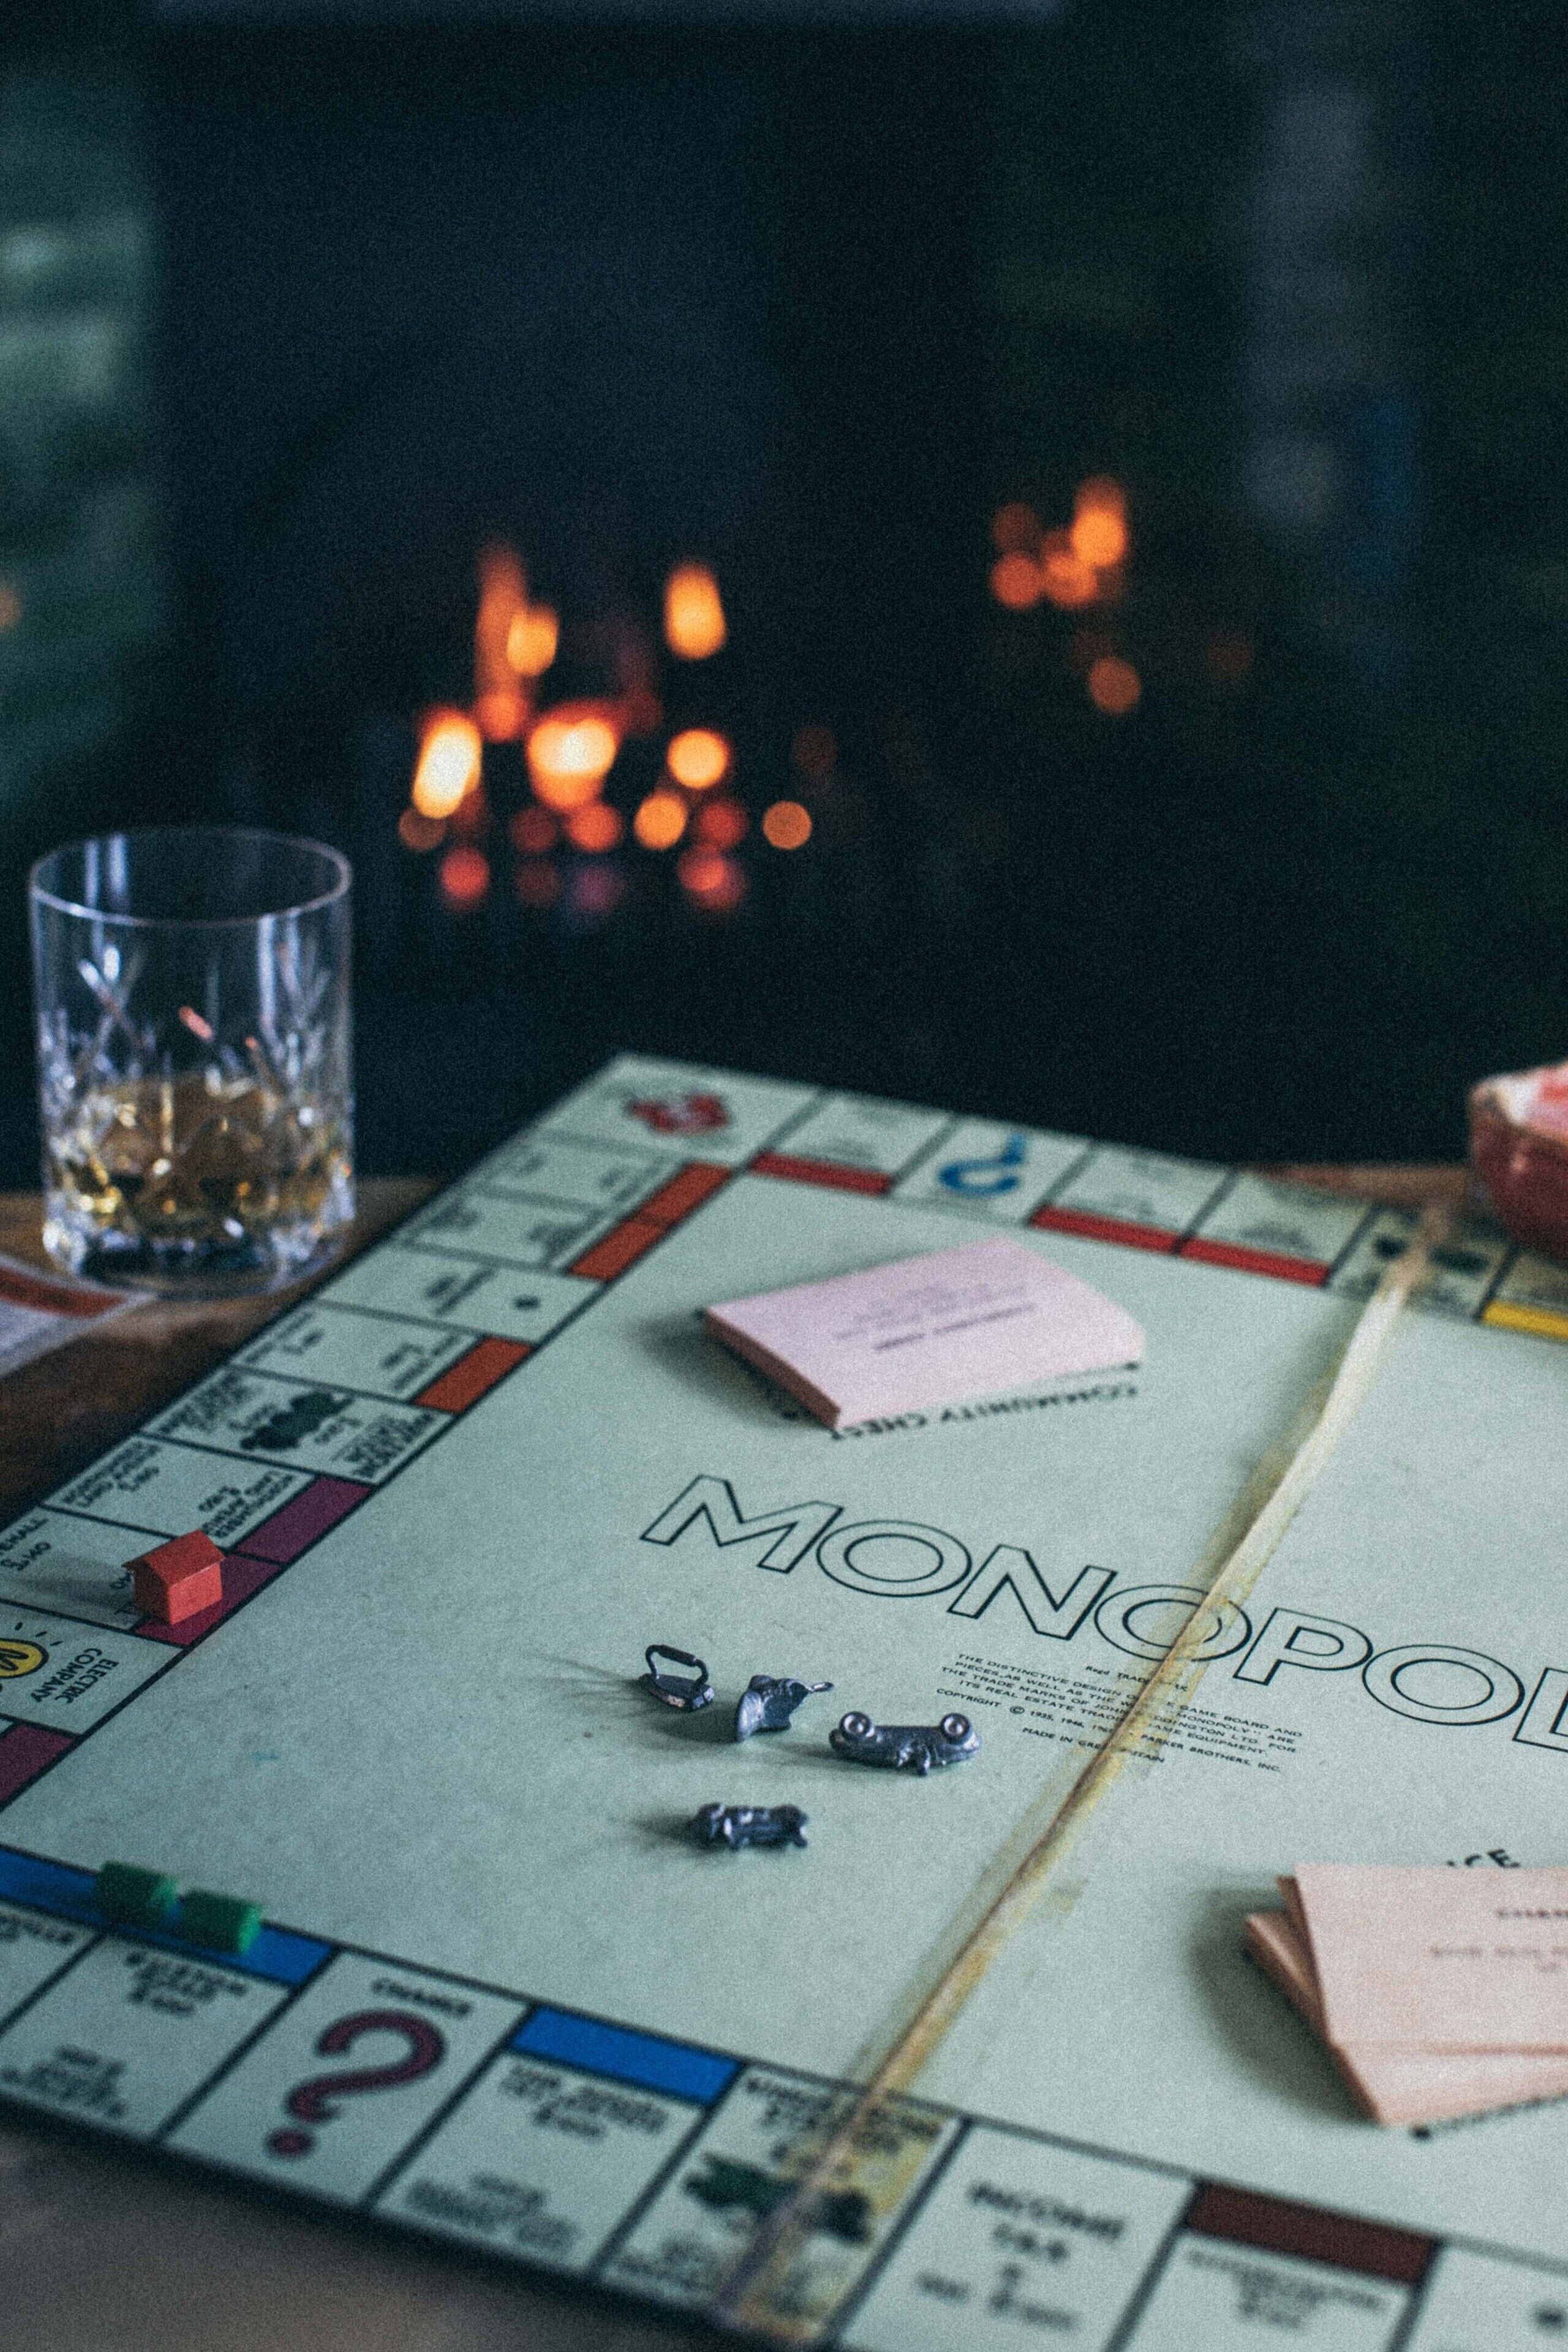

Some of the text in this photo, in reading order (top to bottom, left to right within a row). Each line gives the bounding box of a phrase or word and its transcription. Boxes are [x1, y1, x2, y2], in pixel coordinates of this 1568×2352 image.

[640, 1474, 1568, 1752] MONOPOL
[30, 1647, 103, 1703] COMPANY
[55, 1658, 120, 1705] ELECTRIC
[958, 1653, 984, 1664] THE
[987, 1660, 1069, 1684] DISTINCTIVE
[1072, 1681, 1122, 1697] DESIGN
[1180, 1705, 1218, 1718] GAME
[1223, 1715, 1270, 1730] BOARD
[1274, 1727, 1303, 1738] AND
[936, 1687, 1002, 1708] COPYRIGHT
[1140, 1733, 1185, 1751] PARKER
[941, 1666, 968, 1677] THE
[971, 1673, 1015, 1689] TRADE
[1018, 1685, 1066, 1701] MARKS
[1070, 1697, 1090, 1706] OF
[1153, 1714, 1226, 1738] DDINGTON
[1267, 1743, 1297, 1754] FOR
[959, 1679, 981, 1690] ITS
[984, 1686, 1019, 1699] REAL
[1024, 1695, 1075, 1712] ESTATE
[1149, 1724, 1182, 1736] AME
[1022, 1727, 1056, 1740] MADE
[1059, 1735, 1074, 1744] IN
[1077, 1740, 1104, 1750] GRE
[1026, 1678, 1061, 1692] WELL
[1065, 1688, 1084, 1697] AS
[1089, 1693, 1115, 1703] THE
[1266, 1733, 1295, 1745] ARE
